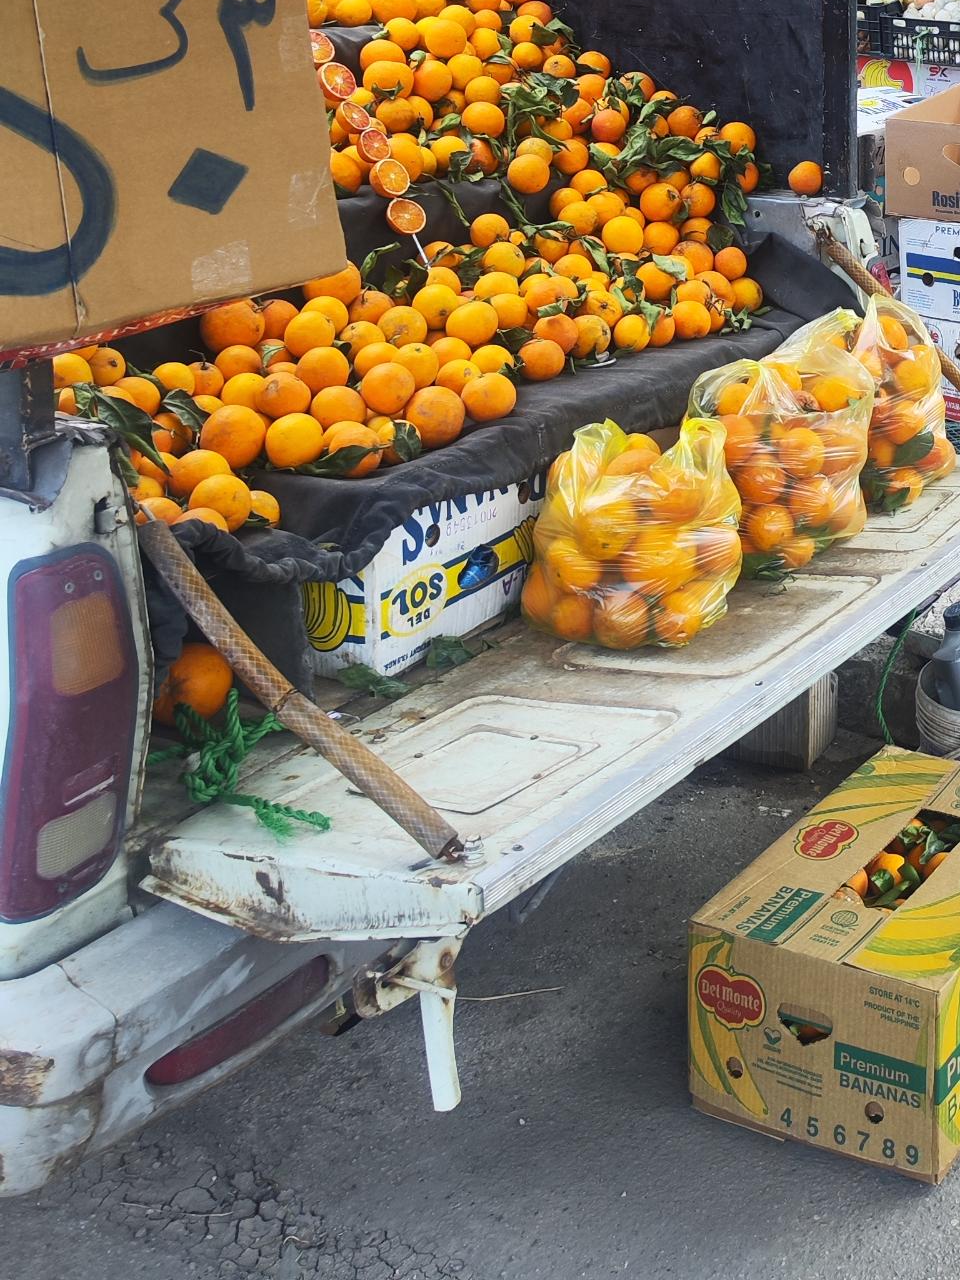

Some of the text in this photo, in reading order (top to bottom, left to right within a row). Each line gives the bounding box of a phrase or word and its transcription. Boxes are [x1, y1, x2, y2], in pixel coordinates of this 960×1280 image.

[392, 572, 444, 616] SOL
[407, 607, 431, 628] DEL
[806, 834, 838, 857] Monte
[735, 885, 796, 933] BANANAS
[760, 889, 814, 931] Premium
[701, 978, 760, 1012] Del Monte
[863, 1000, 896, 1016] PRODUCT
[869, 985, 894, 1001] STORE
[840, 1051, 910, 1085] Premium
[839, 1074, 922, 1109] BANANAS
[780, 1107, 919, 1166] 4 5 6 7 8 9
